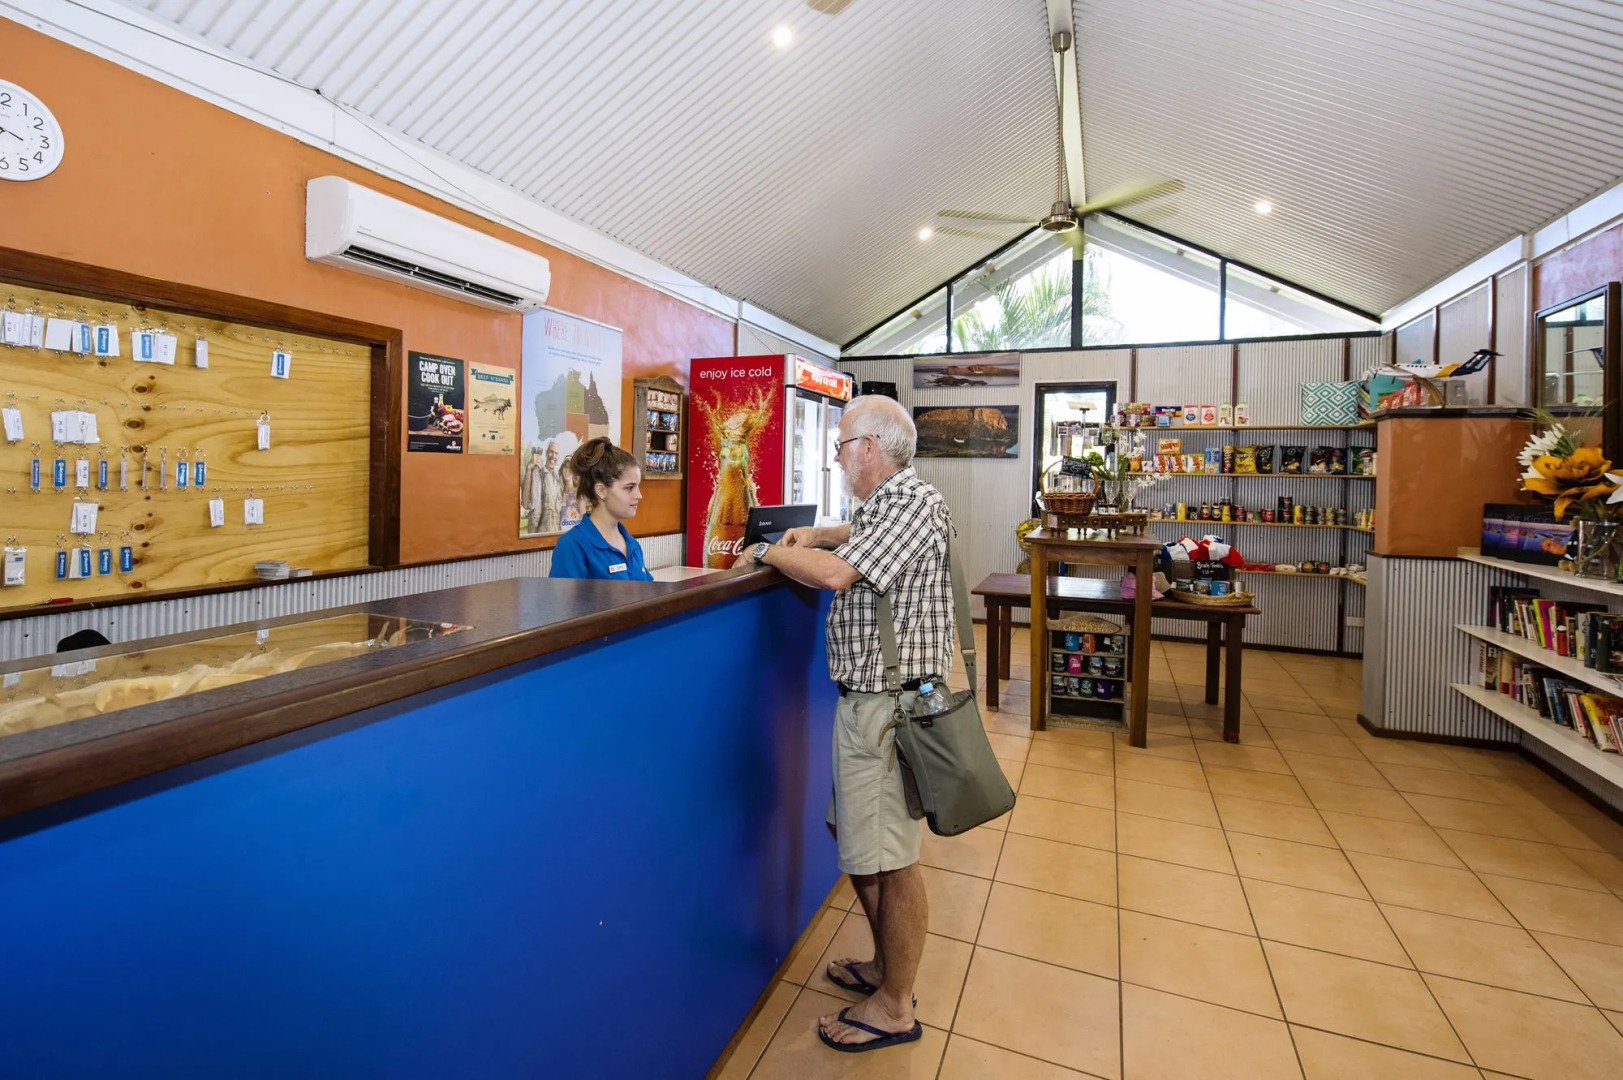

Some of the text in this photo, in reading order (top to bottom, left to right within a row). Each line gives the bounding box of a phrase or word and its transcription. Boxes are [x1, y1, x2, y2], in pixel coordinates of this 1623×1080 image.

[22, 103, 27, 116] 1
[33, 117, 44, 131] 2
[40, 135, 50, 149] 3
[18, 157, 29, 171] 5
[33, 151, 43, 164] 4
[419, 361, 456, 376] CAMP OVEN
[700, 366, 772, 380] enjoy ice cold
[421, 372, 454, 386] COOK OUT
